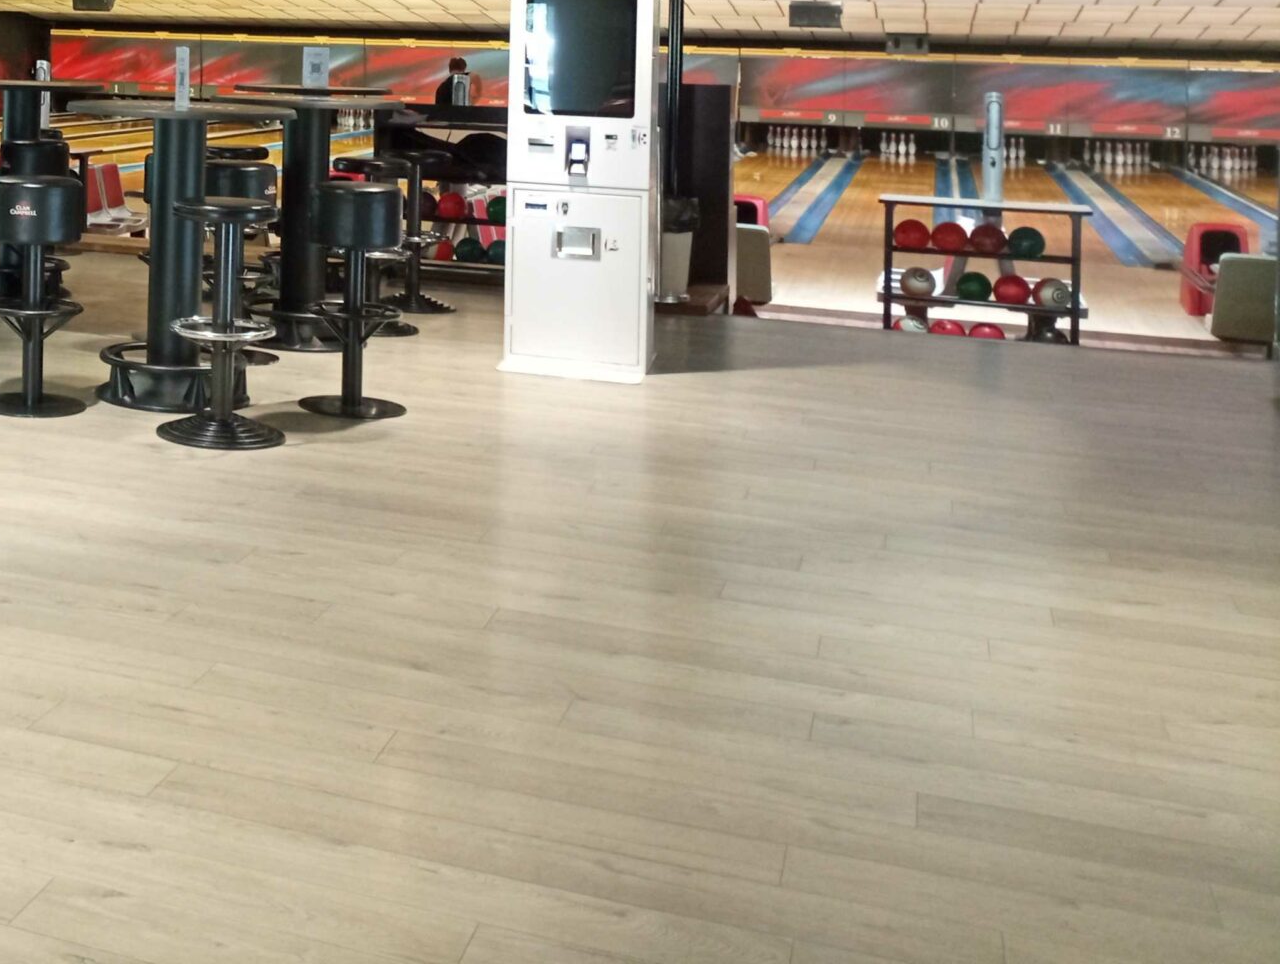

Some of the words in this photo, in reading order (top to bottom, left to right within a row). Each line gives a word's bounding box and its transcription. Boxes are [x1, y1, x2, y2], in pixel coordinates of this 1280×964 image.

[827, 113, 837, 124] 9
[933, 117, 949, 129] 10
[1048, 123, 1061, 135] 11
[1166, 127, 1181, 139] 12
